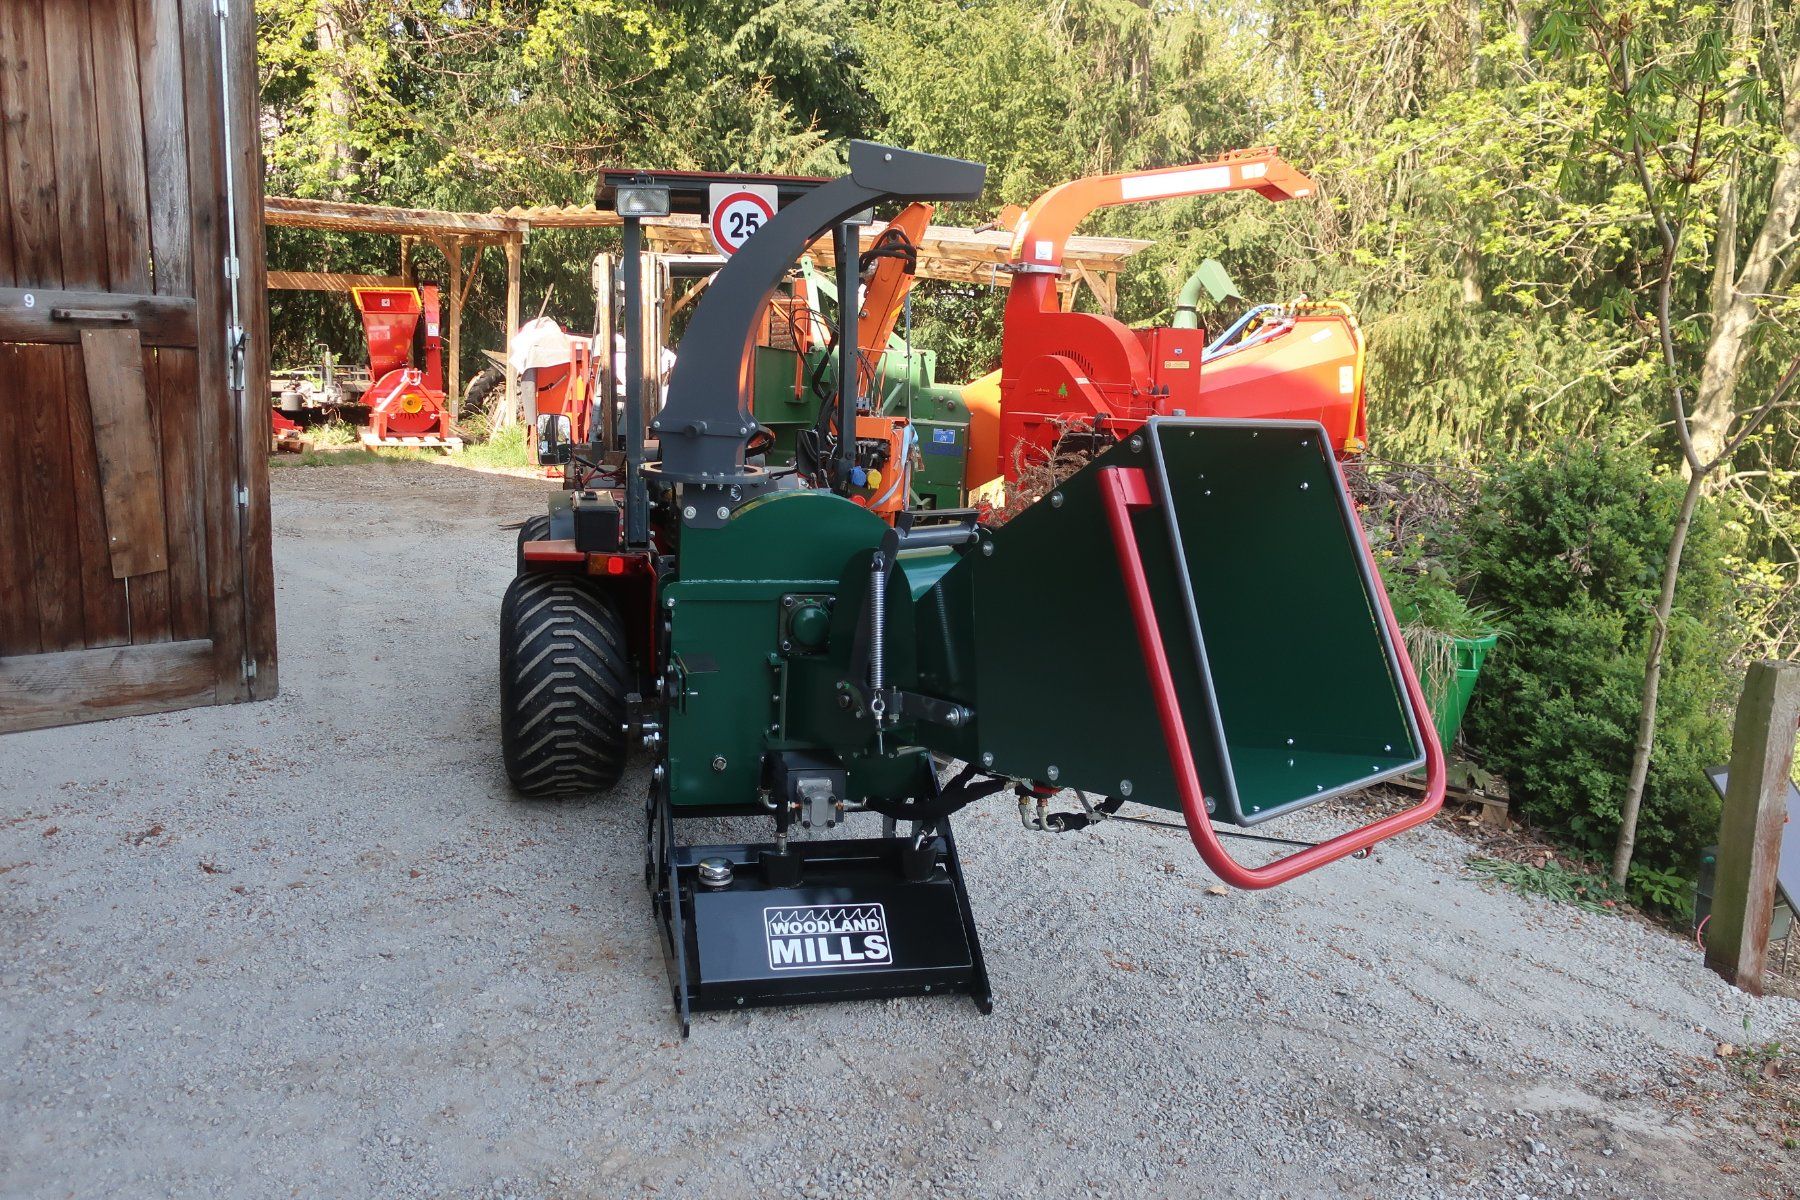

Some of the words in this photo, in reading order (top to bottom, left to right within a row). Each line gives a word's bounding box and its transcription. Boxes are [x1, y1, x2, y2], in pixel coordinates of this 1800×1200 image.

[730, 212, 759, 238] 25
[24, 293, 35, 308] 9
[771, 918, 880, 935] WOODLAND
[771, 935, 888, 964] MILLS
